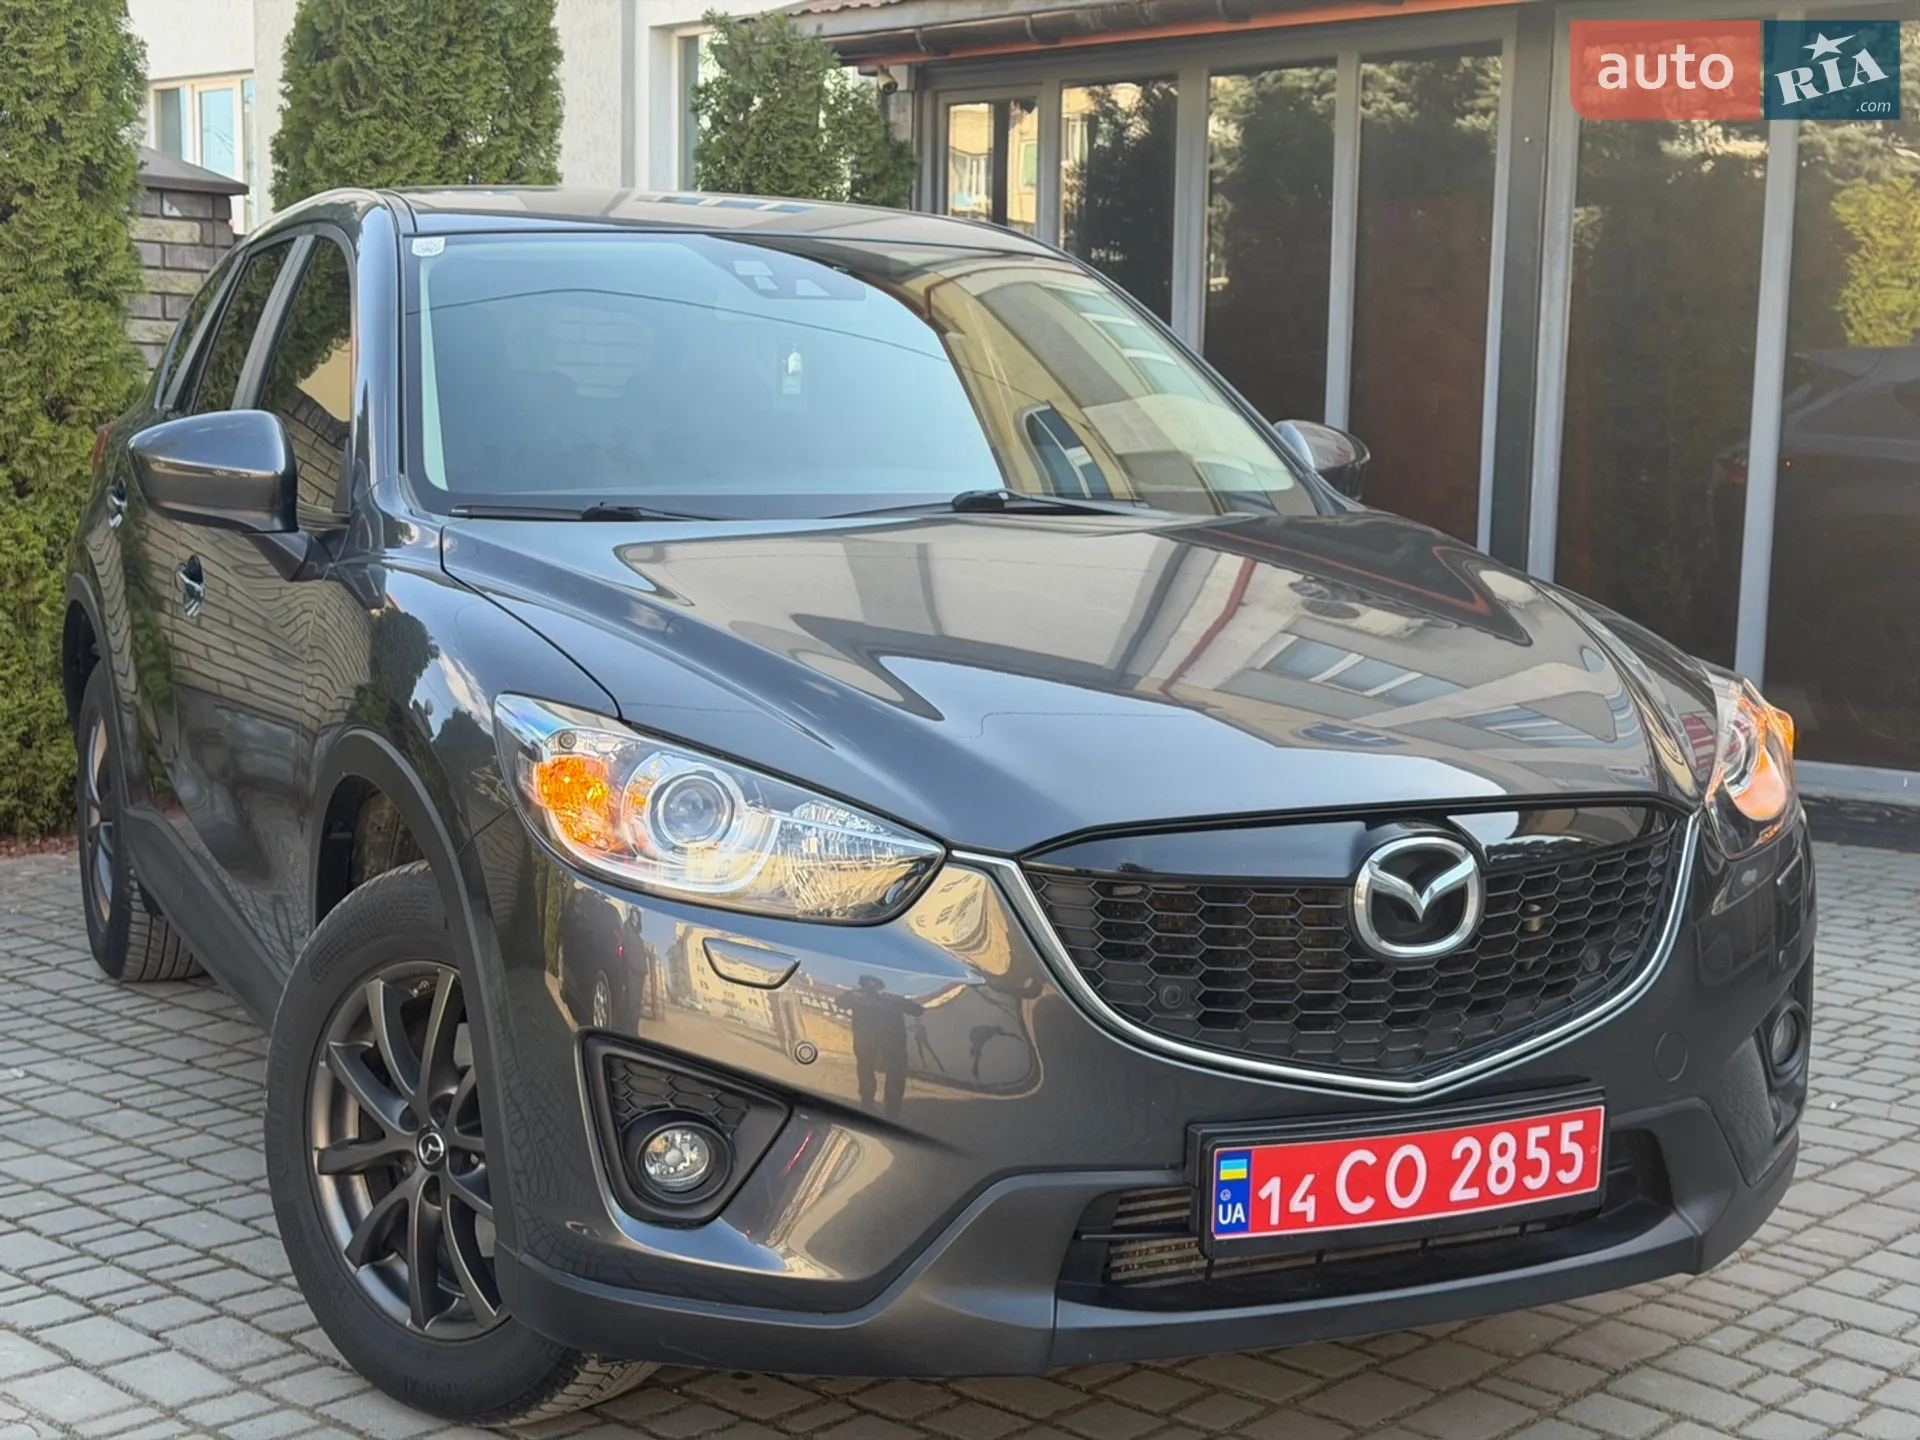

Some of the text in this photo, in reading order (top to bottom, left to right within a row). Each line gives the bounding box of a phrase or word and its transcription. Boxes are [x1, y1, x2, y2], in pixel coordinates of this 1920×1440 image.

[1258, 1119, 1584, 1225] 14 CO 2855
[1218, 1203, 1246, 1225] UA
